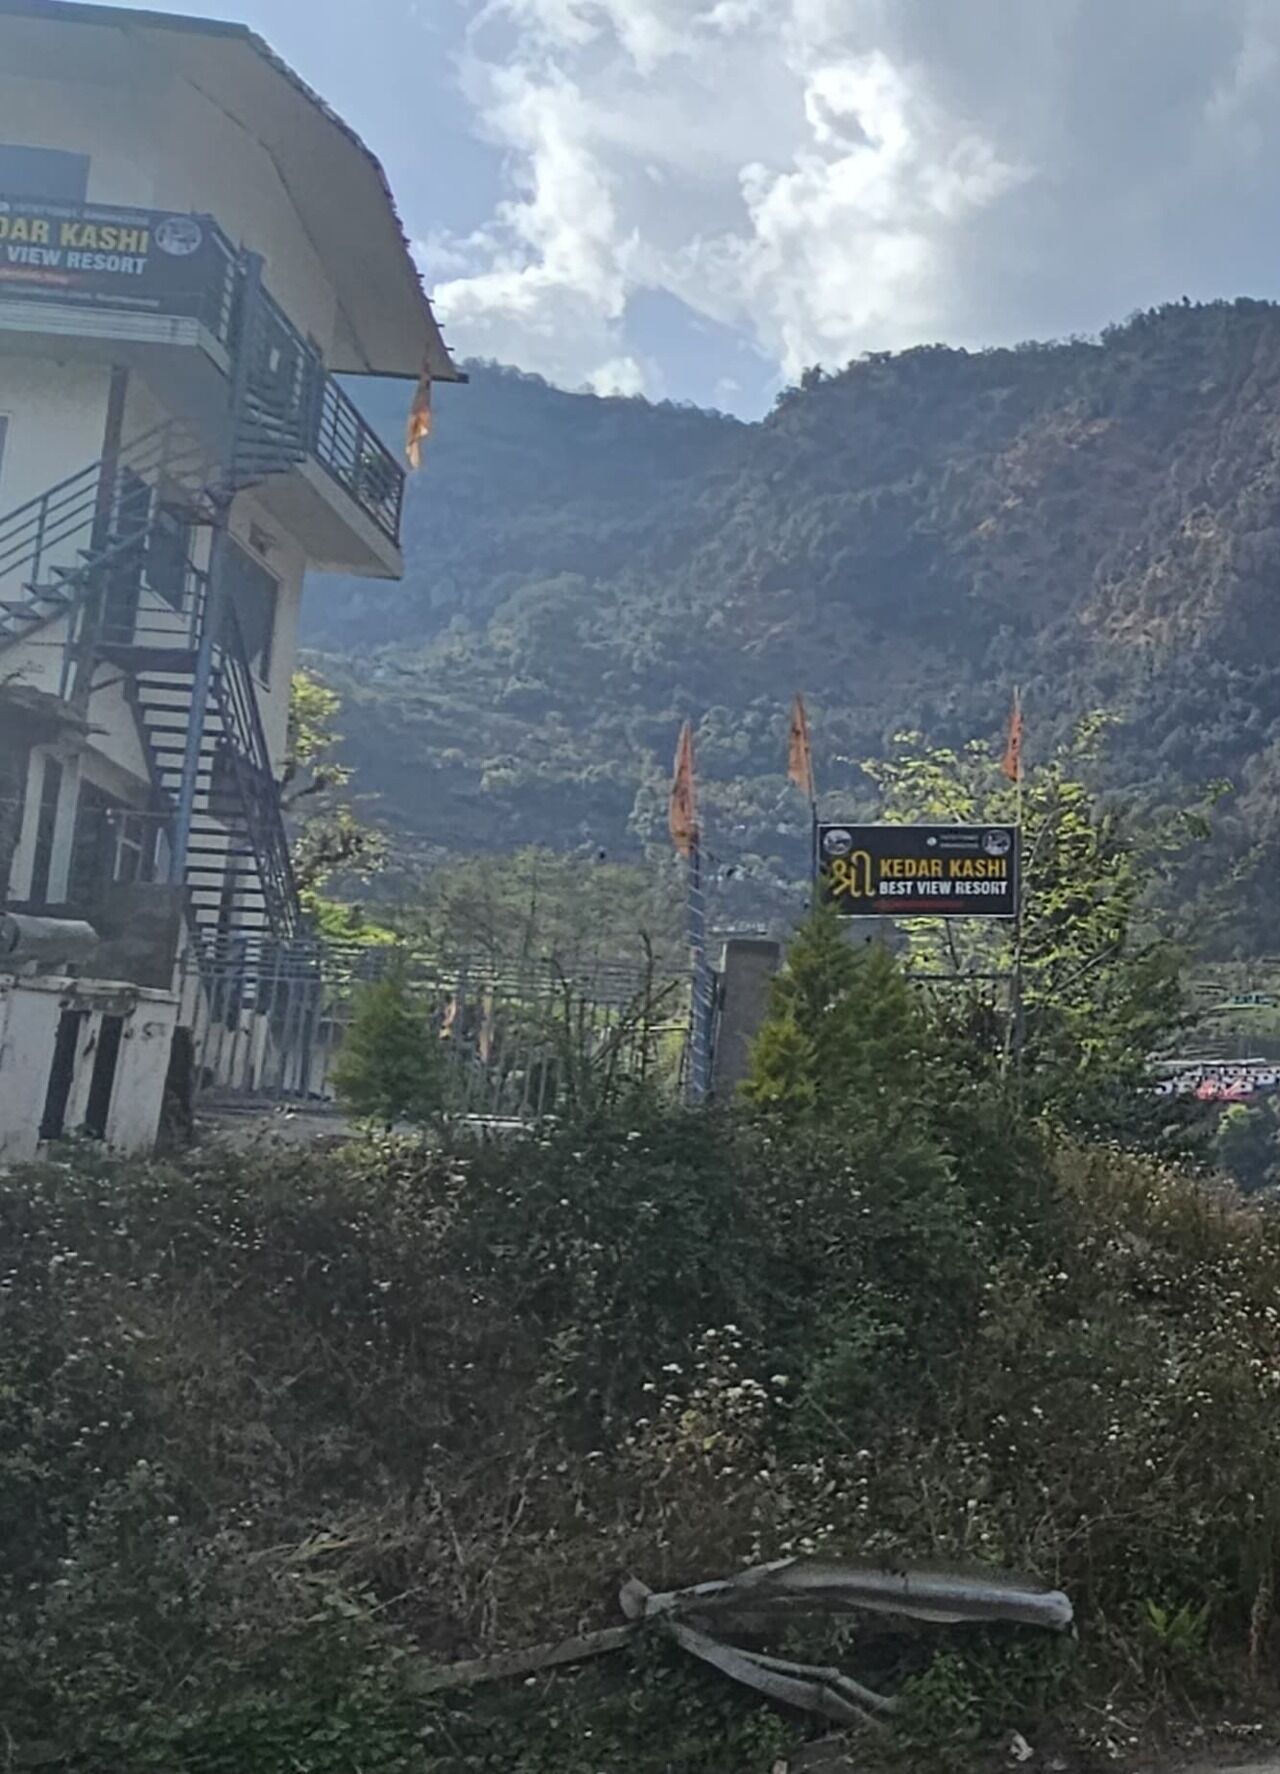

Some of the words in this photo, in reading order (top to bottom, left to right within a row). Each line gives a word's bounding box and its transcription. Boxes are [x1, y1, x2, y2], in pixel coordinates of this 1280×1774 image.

[60, 223, 149, 253] KASHI
[8, 246, 61, 266] VIEW
[67, 251, 147, 275] RESORT
[832, 850, 876, 897] श्री
[879, 859, 943, 877] KEDAR
[950, 859, 1007, 878] KASHI
[879, 881, 912, 894] BEST
[916, 881, 951, 895] VIEW
[955, 881, 1008, 895] RESORT
